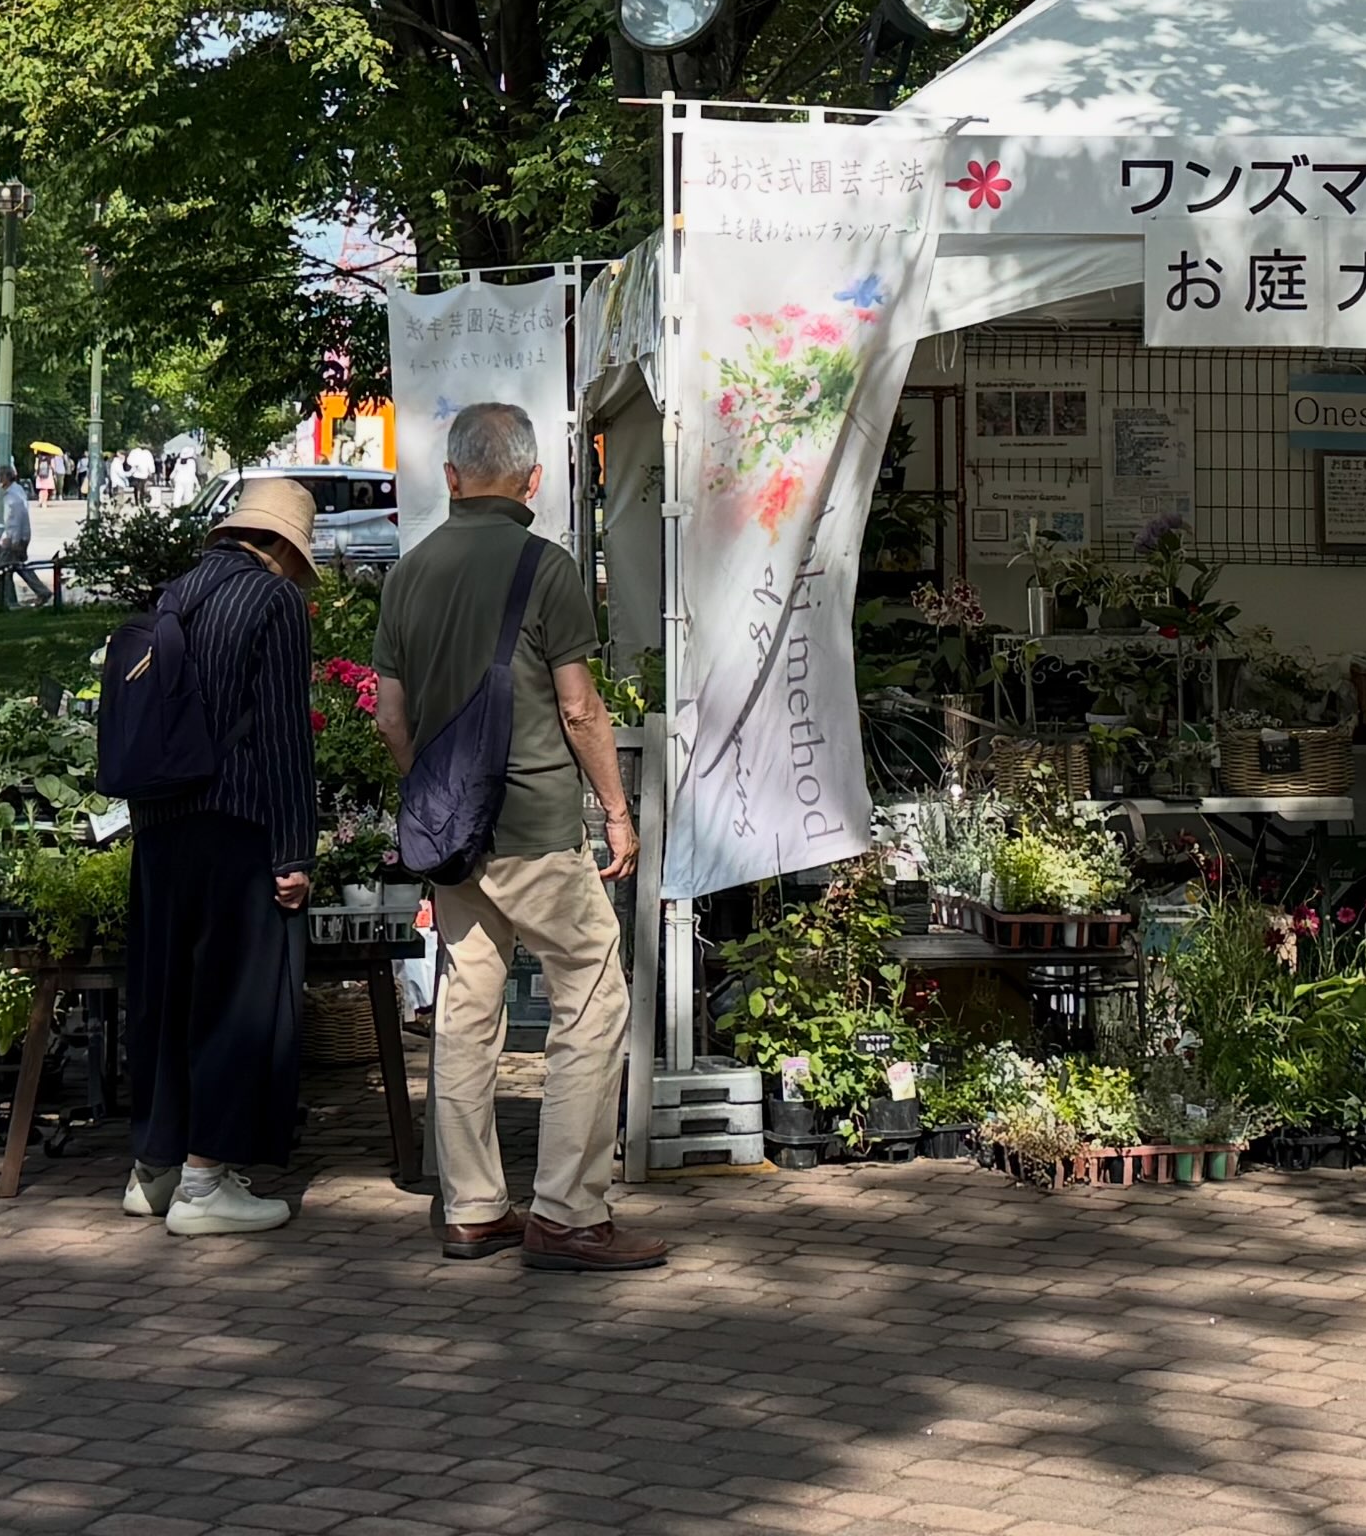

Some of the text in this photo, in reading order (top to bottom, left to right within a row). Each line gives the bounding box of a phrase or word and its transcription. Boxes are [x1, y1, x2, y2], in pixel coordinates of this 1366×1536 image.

[706, 152, 925, 196] あおき式園芸手法
[786, 634, 844, 845] method
